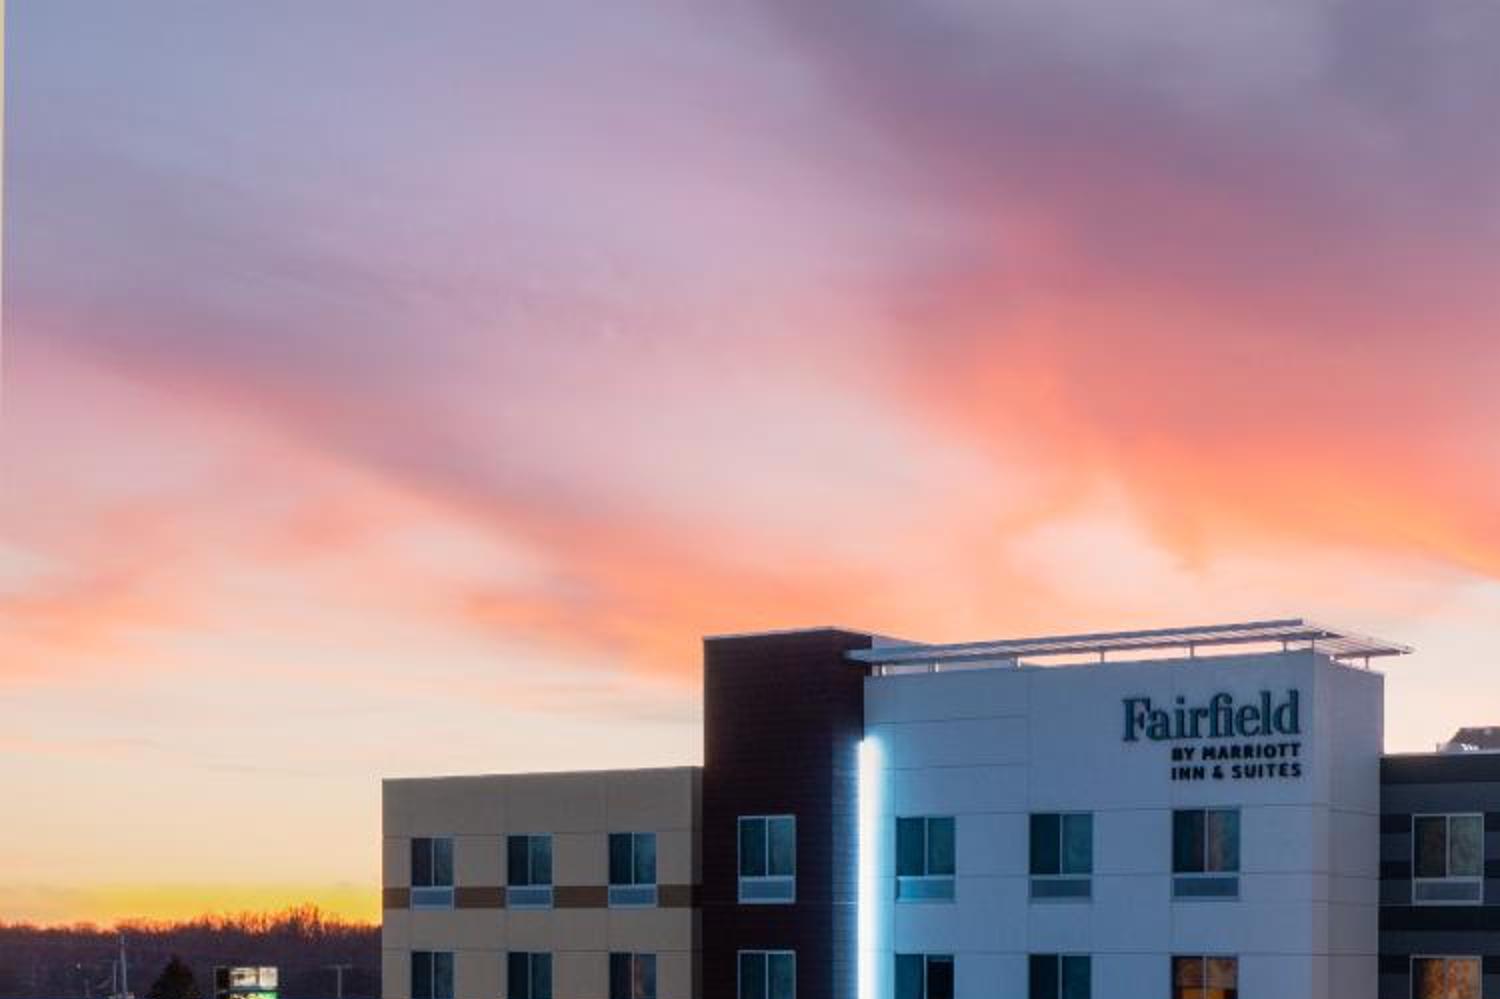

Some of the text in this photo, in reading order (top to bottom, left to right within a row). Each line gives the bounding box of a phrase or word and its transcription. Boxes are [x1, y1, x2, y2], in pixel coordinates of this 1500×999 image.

[1121, 689, 1302, 742] Fairfield
[1171, 743, 1302, 761] BY MARRIOTT
[1171, 763, 1302, 781] INN & SUITES
